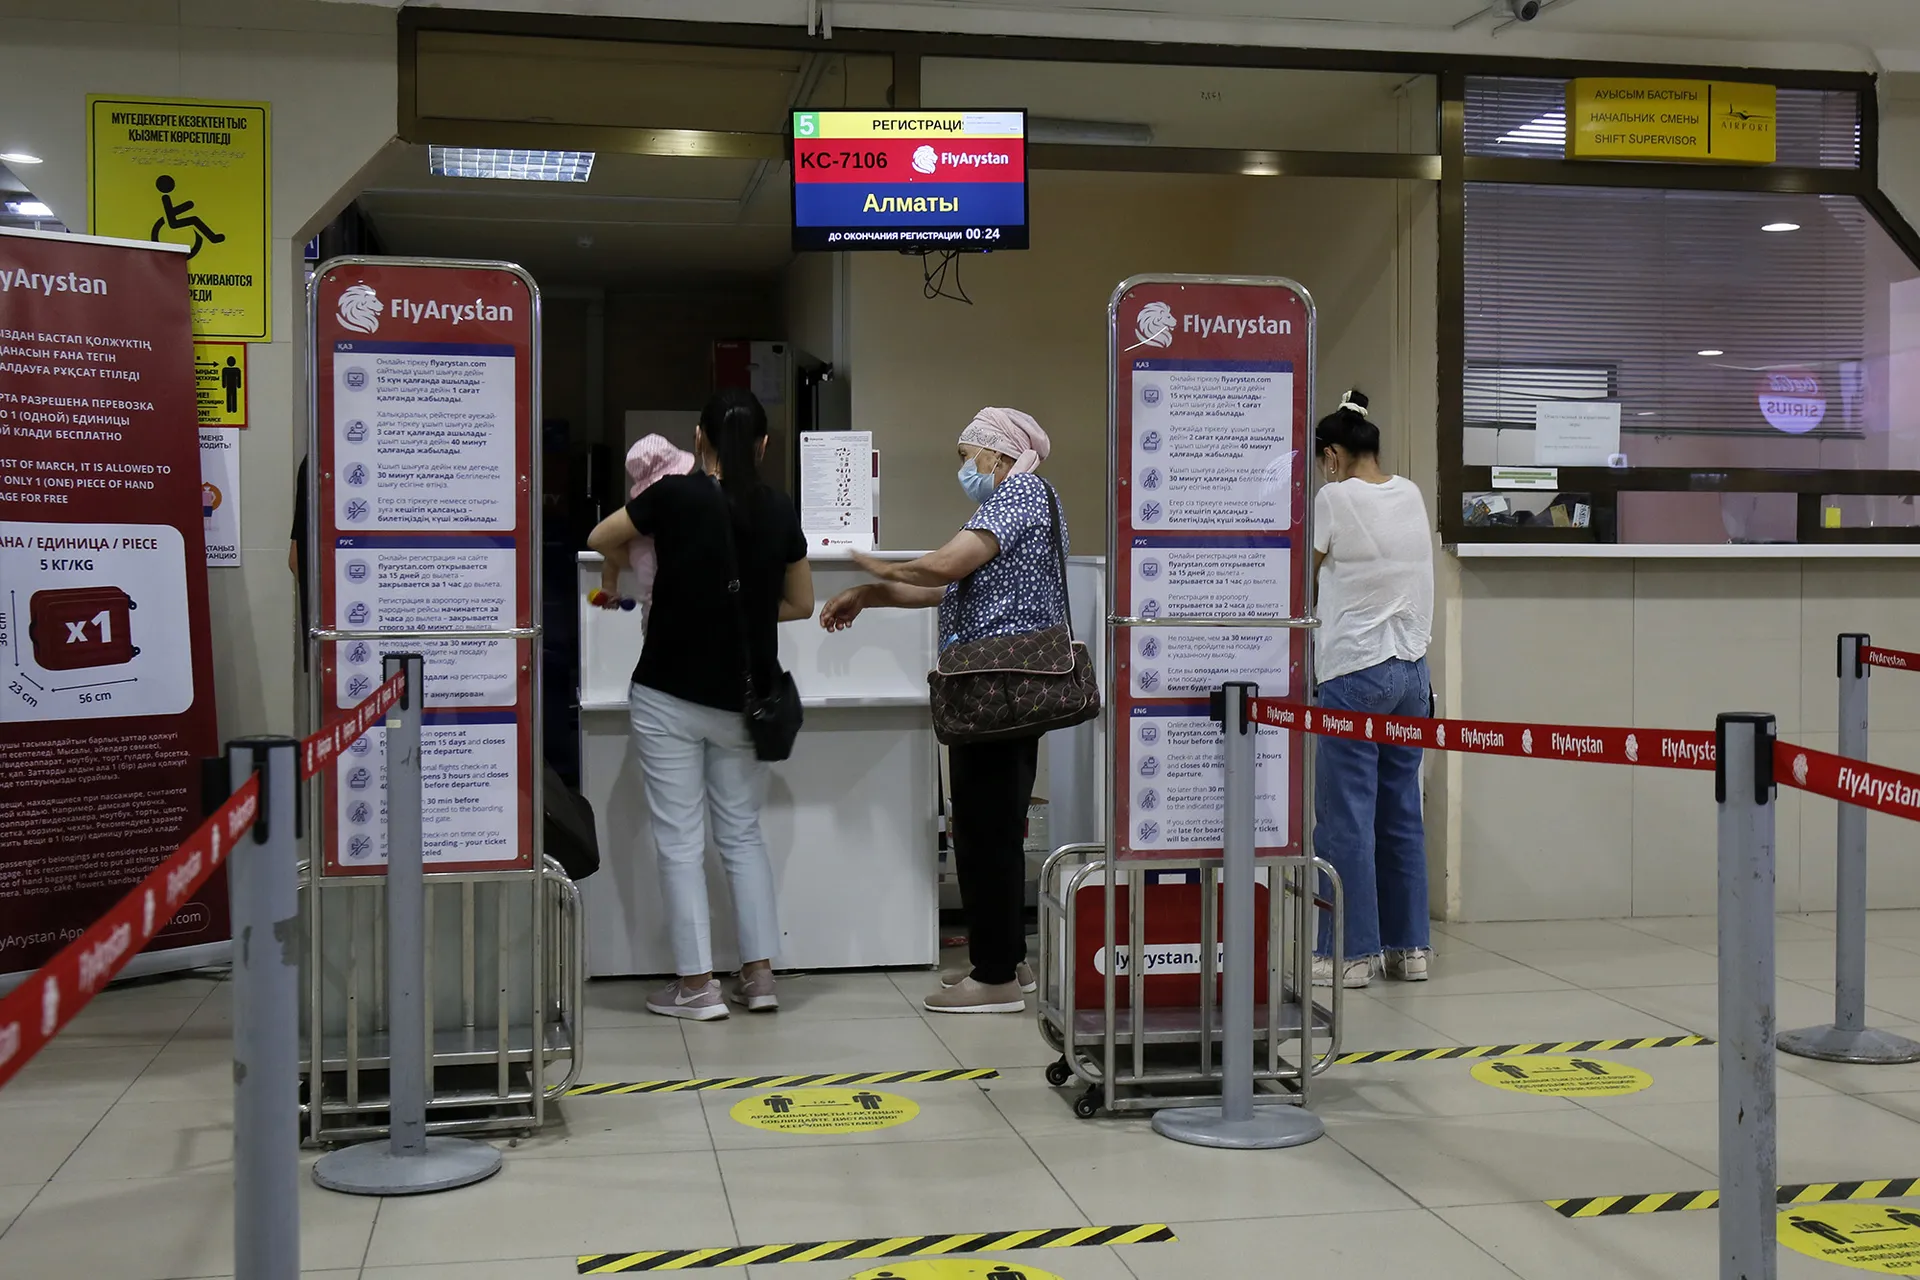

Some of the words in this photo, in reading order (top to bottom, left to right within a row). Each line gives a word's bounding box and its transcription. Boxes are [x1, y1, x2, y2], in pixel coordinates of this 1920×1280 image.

[1595, 90, 1645, 100] АУЫСЫМ
[1647, 90, 1698, 101] БАСТЫҒЫ
[178, 116, 225, 129] КЕЗЕКТЕН
[226, 117, 247, 130] ТЫС
[799, 115, 814, 135] 5
[872, 119, 964, 133] РЕГИСТРАЦИ
[1590, 113, 1655, 123] НАЧАЛЬНИК
[1660, 114, 1699, 125] СМЕНЫ
[1721, 121, 1769, 132] AIRPORT
[128, 129, 169, 142] ҚЫЗМЕТ
[1595, 134, 1625, 144] SHIFT
[1628, 134, 1697, 146] SUPERVISOR
[941, 152, 1009, 167] FlyArystan
[863, 194, 959, 213] Алматы
[828, 232, 842, 242] ДО
[844, 232, 899, 240] ОКОНЧАНИЯ
[900, 232, 962, 242] РЕГИСТРАЦИИ
[965, 228, 1000, 240] 00:24
[391, 298, 514, 325] FlyArystan
[1183, 314, 1291, 339] FlyArystan
[38, 333, 82, 345] БАСТАП
[85, 336, 152, 351] ҚОЛЖҮКТІҢ
[337, 343, 353, 351] ҚАЗ
[53, 350, 84, 361] ҒАНА
[86, 352, 116, 363] ТЕГІН
[430, 359, 487, 368] flyarystan.com
[100, 370, 140, 382] ЕТІЛЕДІ
[1221, 376, 1272, 384] flyarystan.com
[20, 395, 89, 408] РАЗРЕШЕНА
[92, 398, 154, 411] ПЕРЕВОЗКА
[10, 411, 17, 420] 1
[19, 410, 70, 424] (ОДНОЙ)
[73, 414, 130, 427] ЕДИНИЦЫ
[13, 427, 52, 440] КЛАДИ
[55, 430, 122, 441] БЕСПЛАТНО
[20, 460, 34, 469] OF
[36, 461, 78, 473] MARCH,
[80, 463, 90, 472] IT
[93, 463, 103, 473] IS
[105, 463, 154, 474] ALLOWED
[156, 465, 171, 475] TO
[4, 475, 32, 486] ONLY
[35, 477, 41, 486] 1
[44, 477, 74, 489] (ONE)
[76, 479, 105, 488] PIECE
[108, 479, 122, 489] OF
[124, 480, 154, 490] HAND
[20, 493, 42, 503] FOR
[44, 494, 68, 504] FREE
[37, 537, 110, 552] ЕДИНИЦА
[122, 538, 158, 550] PIECE
[40, 559, 48, 571] 5
[378, 563, 435, 572] flyarystan.com
[1168, 561, 1219, 569] flyarystan.com
[399, 572, 420, 580] дней
[65, 610, 113, 644] x1
[1869, 651, 1907, 667] FlyArystan
[8, 680, 23, 695] 23
[21, 693, 39, 708] cm
[1167, 684, 1190, 692] билет
[79, 693, 93, 704] 56
[94, 691, 112, 702] cm
[1266, 705, 1295, 724] FlyArystan
[1322, 714, 1354, 734] FlyArystan
[434, 730, 458, 738] opens
[1167, 729, 1218, 737] flyarystan.com
[1385, 721, 1422, 742] FlyArystan
[1460, 727, 1504, 750] FlyArystan
[448, 738, 467, 747] days
[1551, 732, 1603, 757] FlyArystan
[1661, 738, 1716, 765] FlyArysta
[424, 781, 450, 789] before
[424, 839, 458, 848] boarding
[465, 839, 484, 847] your
